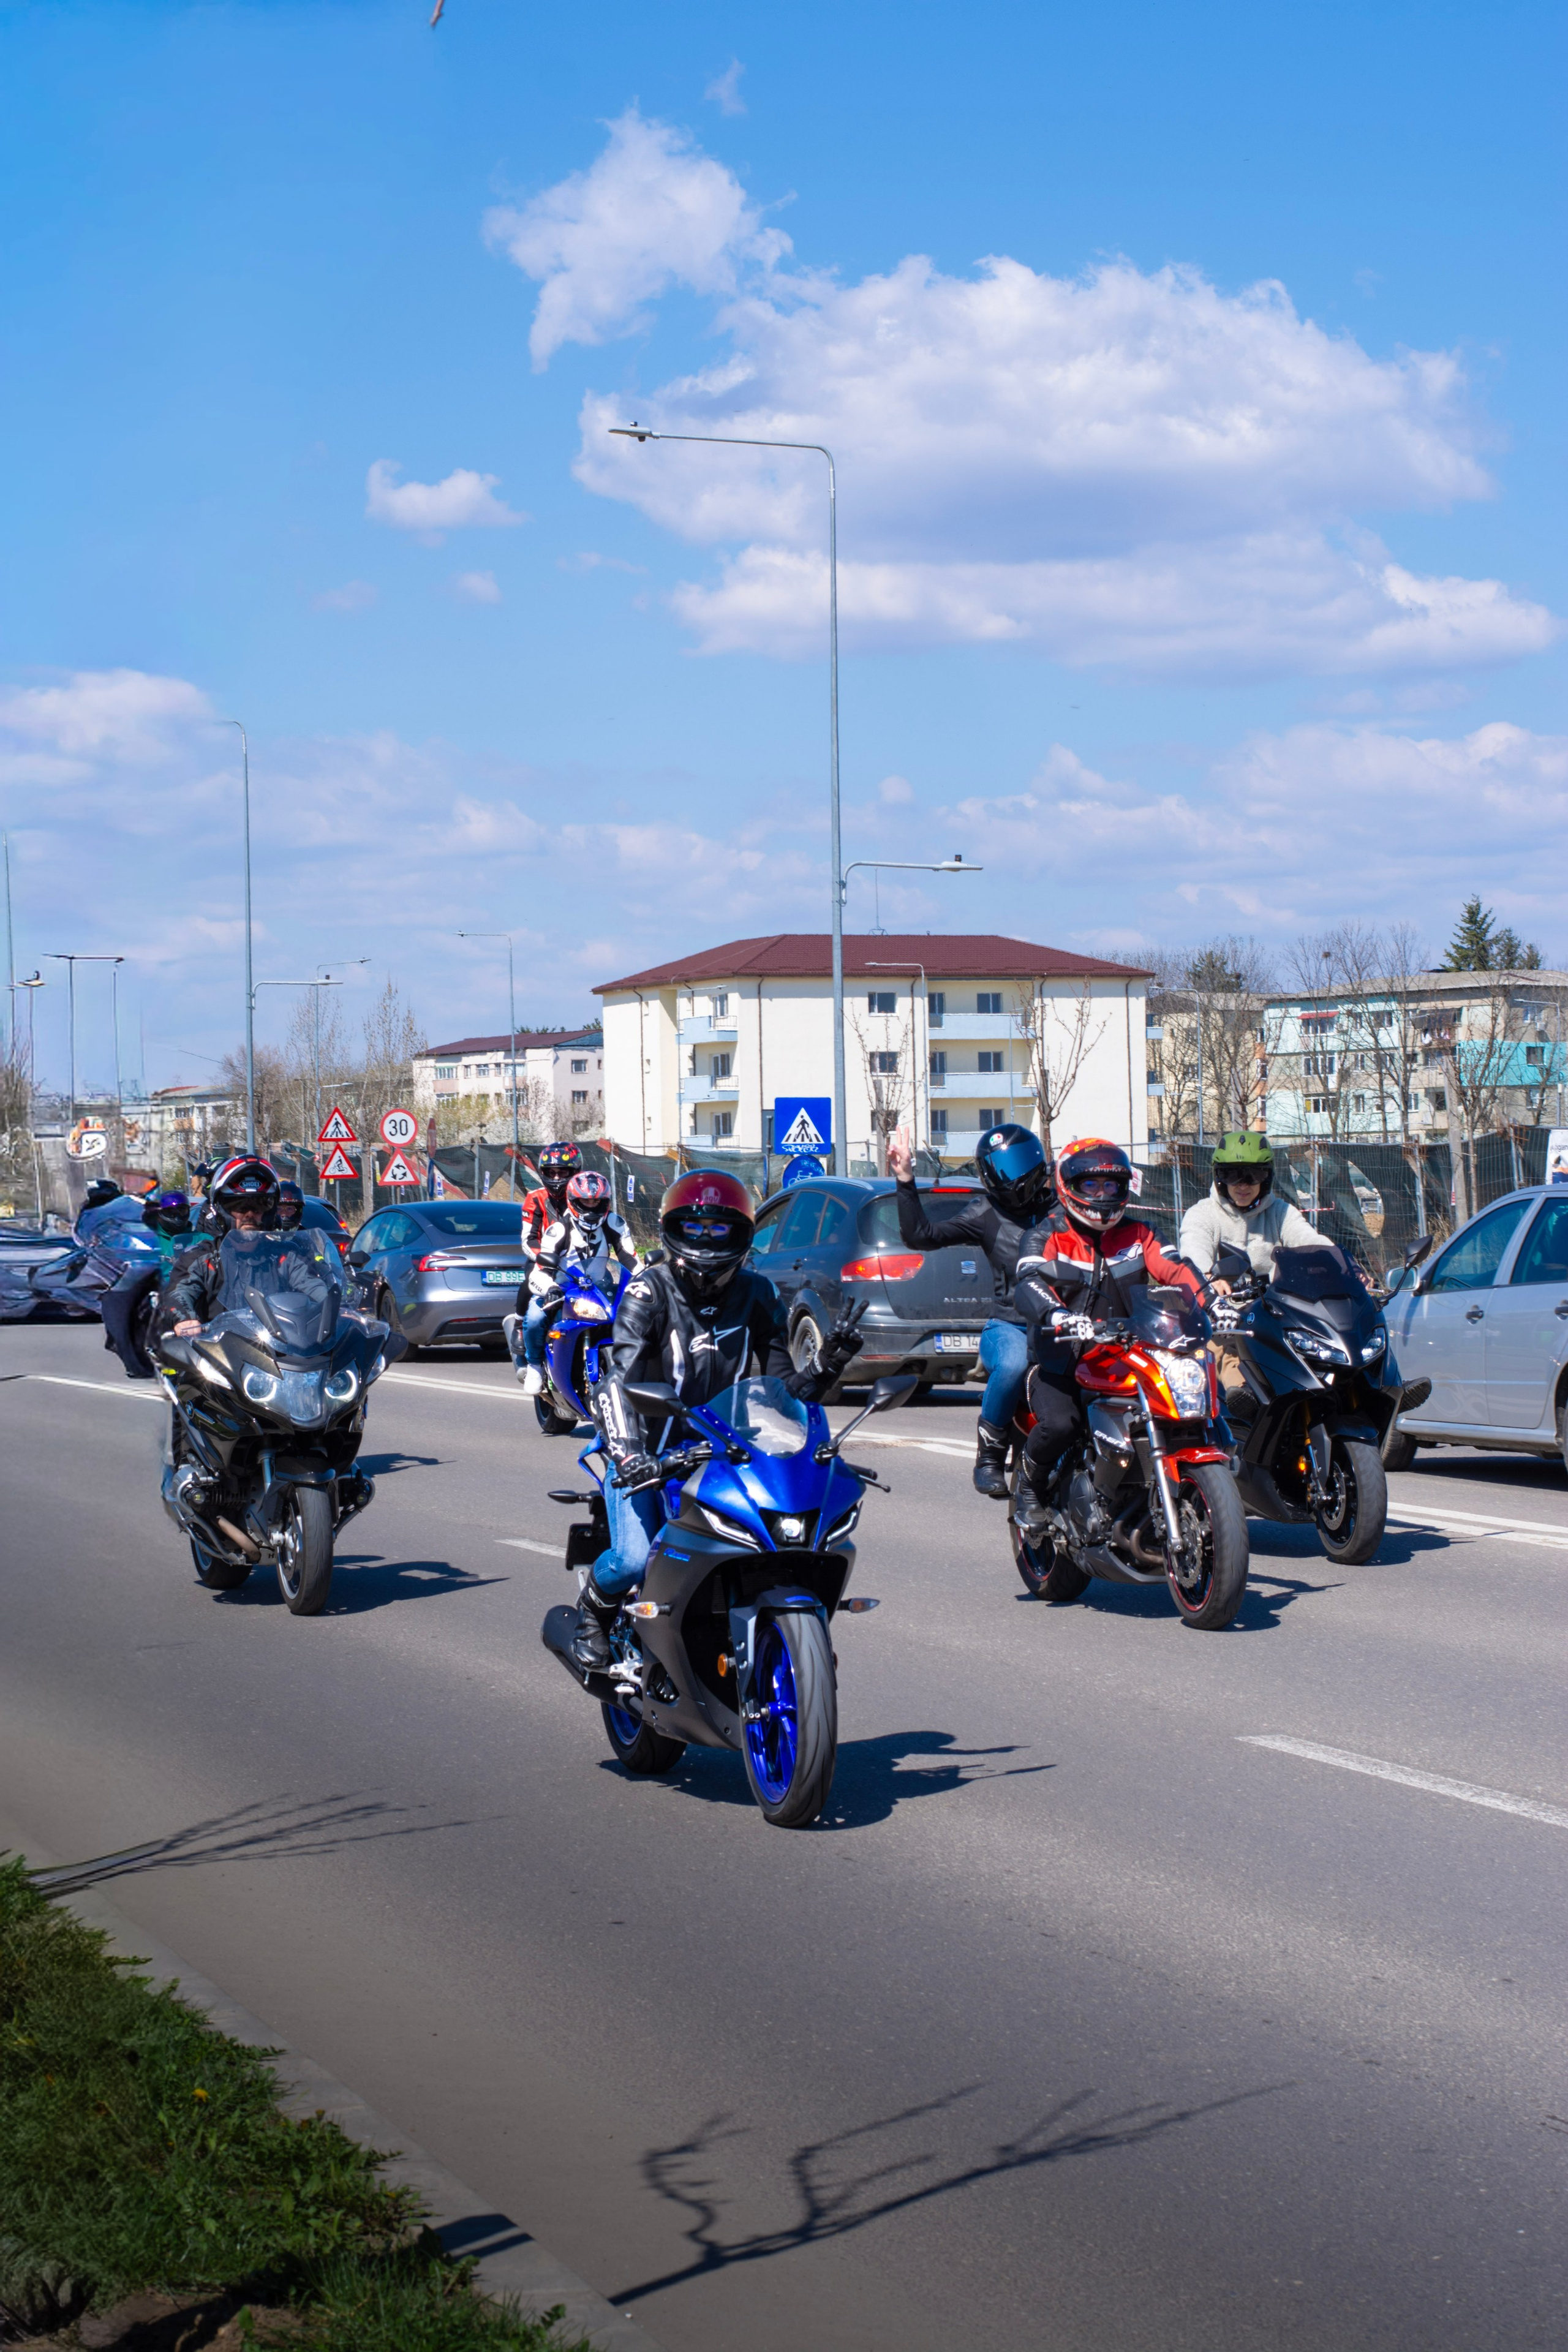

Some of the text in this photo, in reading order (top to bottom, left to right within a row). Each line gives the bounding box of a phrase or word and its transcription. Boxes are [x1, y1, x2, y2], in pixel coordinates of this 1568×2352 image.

[389, 1118, 408, 1136] 30
[488, 1272, 502, 1281] DB
[943, 1335, 962, 1347] DB
[967, 1335, 978, 1347] 14
